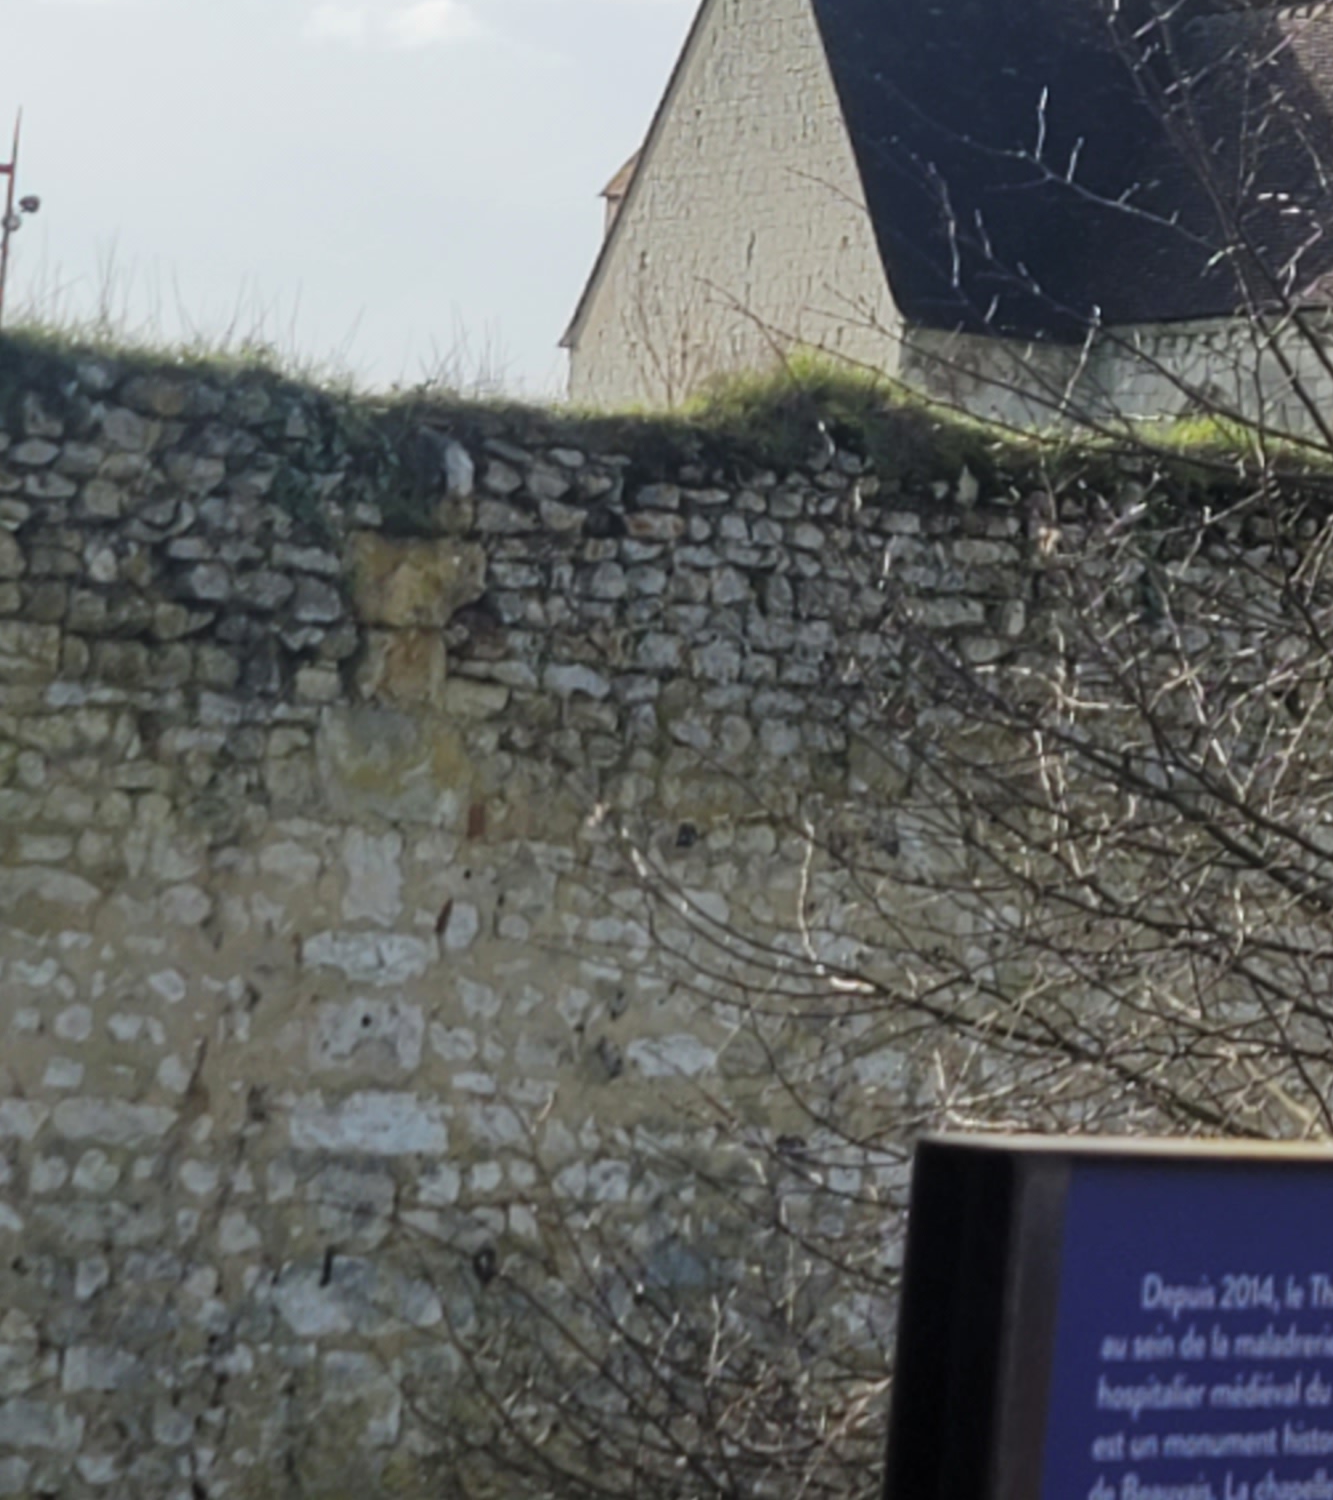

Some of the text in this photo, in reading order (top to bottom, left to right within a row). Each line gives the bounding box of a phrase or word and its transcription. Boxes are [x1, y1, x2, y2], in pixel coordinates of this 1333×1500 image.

[1141, 1272, 1216, 1321] Depuis
[1220, 1274, 1280, 1315] 2014,
[1285, 1274, 1304, 1309] le
[1101, 1335, 1128, 1360] au
[1133, 1322, 1175, 1360] sein
[1179, 1322, 1206, 1359] de
[1210, 1322, 1229, 1358] la
[1097, 1372, 1206, 1422] hospitalier
[1209, 1371, 1301, 1408] médiéval
[1305, 1370, 1331, 1405] du
[1092, 1430, 1125, 1461] est
[1129, 1434, 1158, 1458] un
[1162, 1427, 1279, 1457] monument
[1087, 1474, 1115, 1500] de
[1225, 1470, 1249, 1500] La
